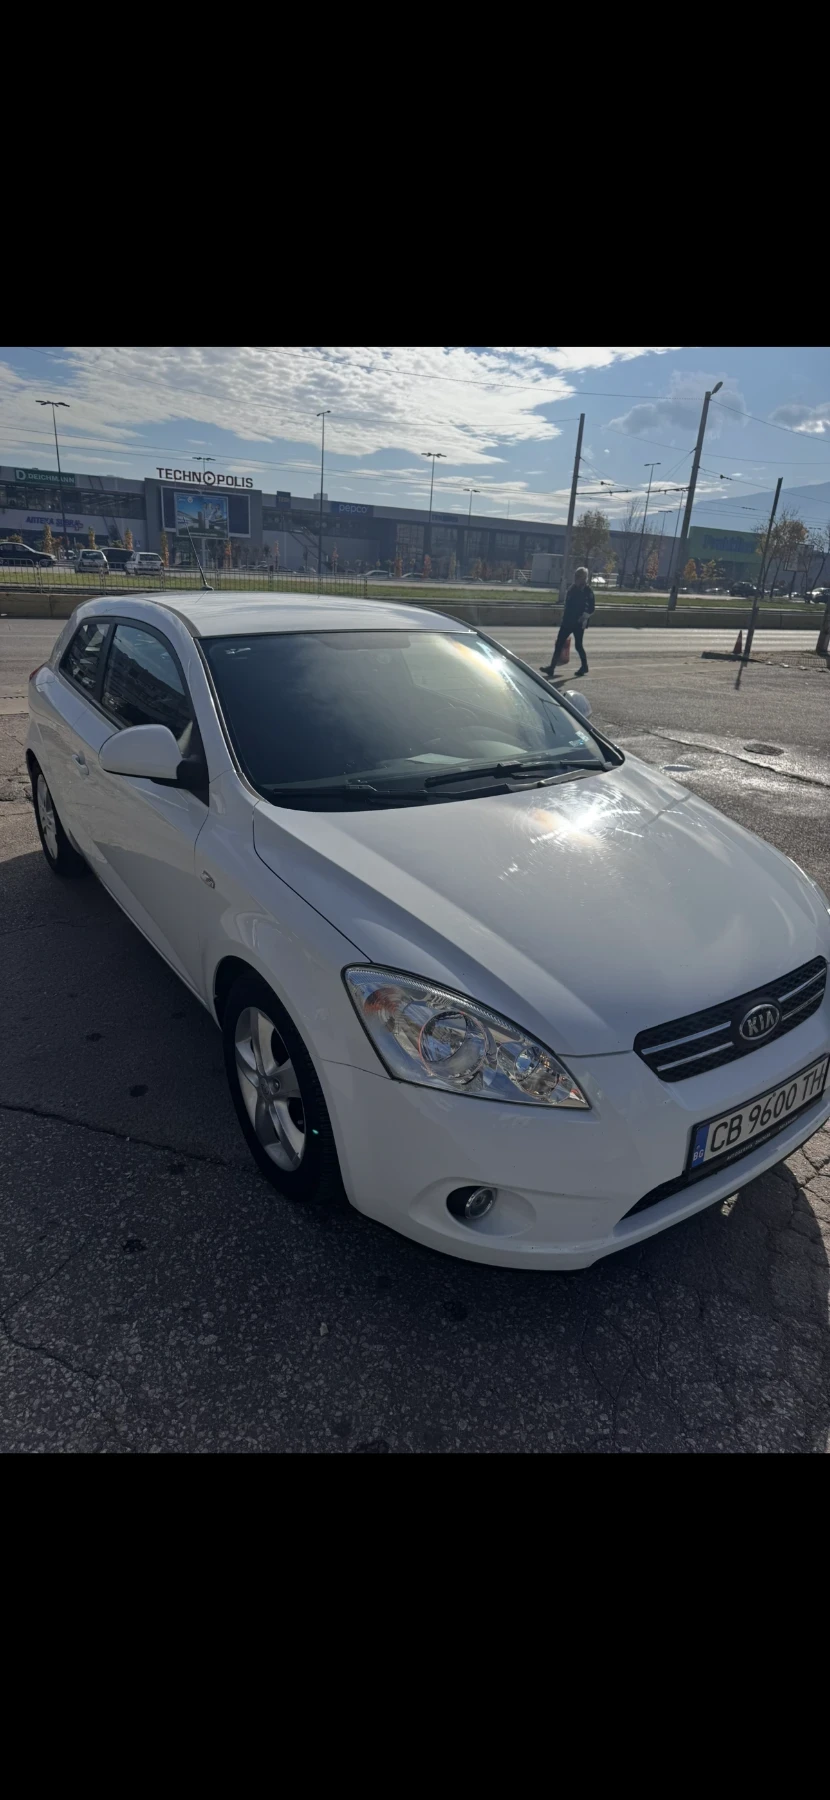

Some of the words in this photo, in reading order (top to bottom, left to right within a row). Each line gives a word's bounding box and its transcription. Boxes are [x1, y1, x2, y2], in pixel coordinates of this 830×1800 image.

[27, 472, 75, 483] DEICHMANN
[156, 467, 254, 488] TECHNOPOLIS
[339, 504, 367, 514] pepco
[747, 1010, 775, 1036] KIA
[693, 1149, 704, 1161] BG
[710, 1113, 743, 1153] CB
[748, 1082, 798, 1134] 9600
[802, 1062, 825, 1101] TH
